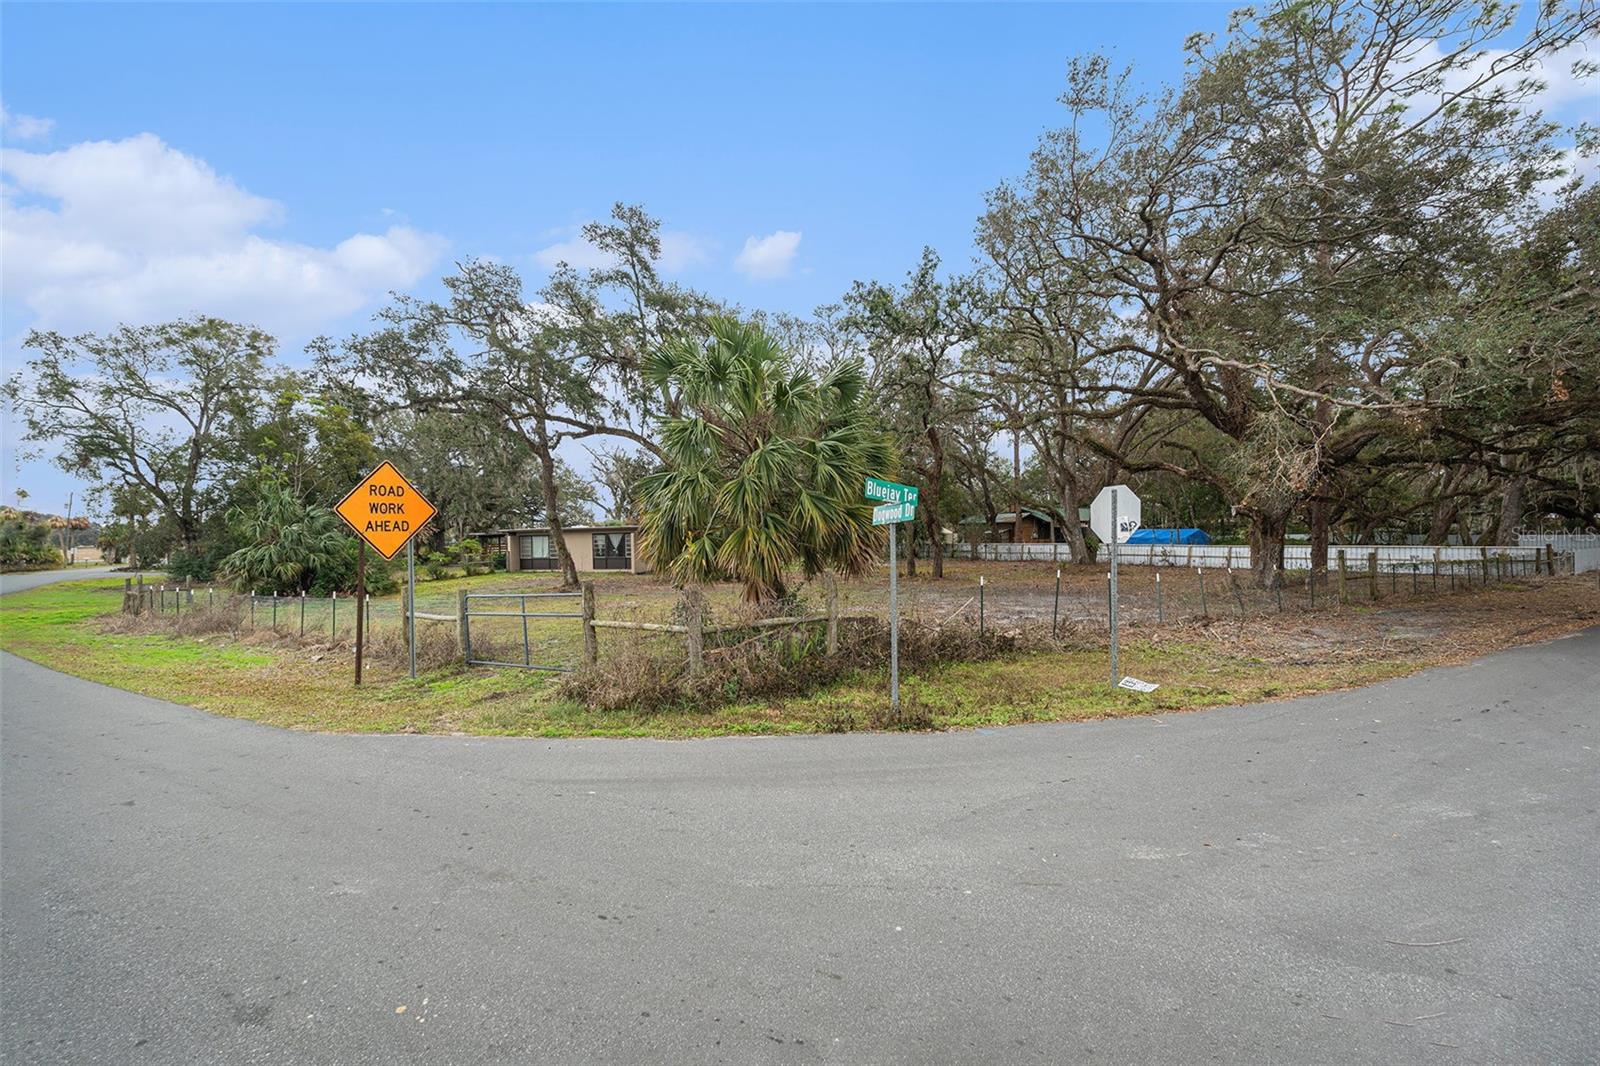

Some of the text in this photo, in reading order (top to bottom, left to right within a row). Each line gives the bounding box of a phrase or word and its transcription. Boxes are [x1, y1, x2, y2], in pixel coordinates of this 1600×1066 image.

[369, 484, 405, 497] ROAD
[867, 480, 917, 502] Bluejay Ter
[369, 502, 405, 515] WORK
[905, 503, 915, 517] Dr
[365, 520, 410, 532] AHEAD
